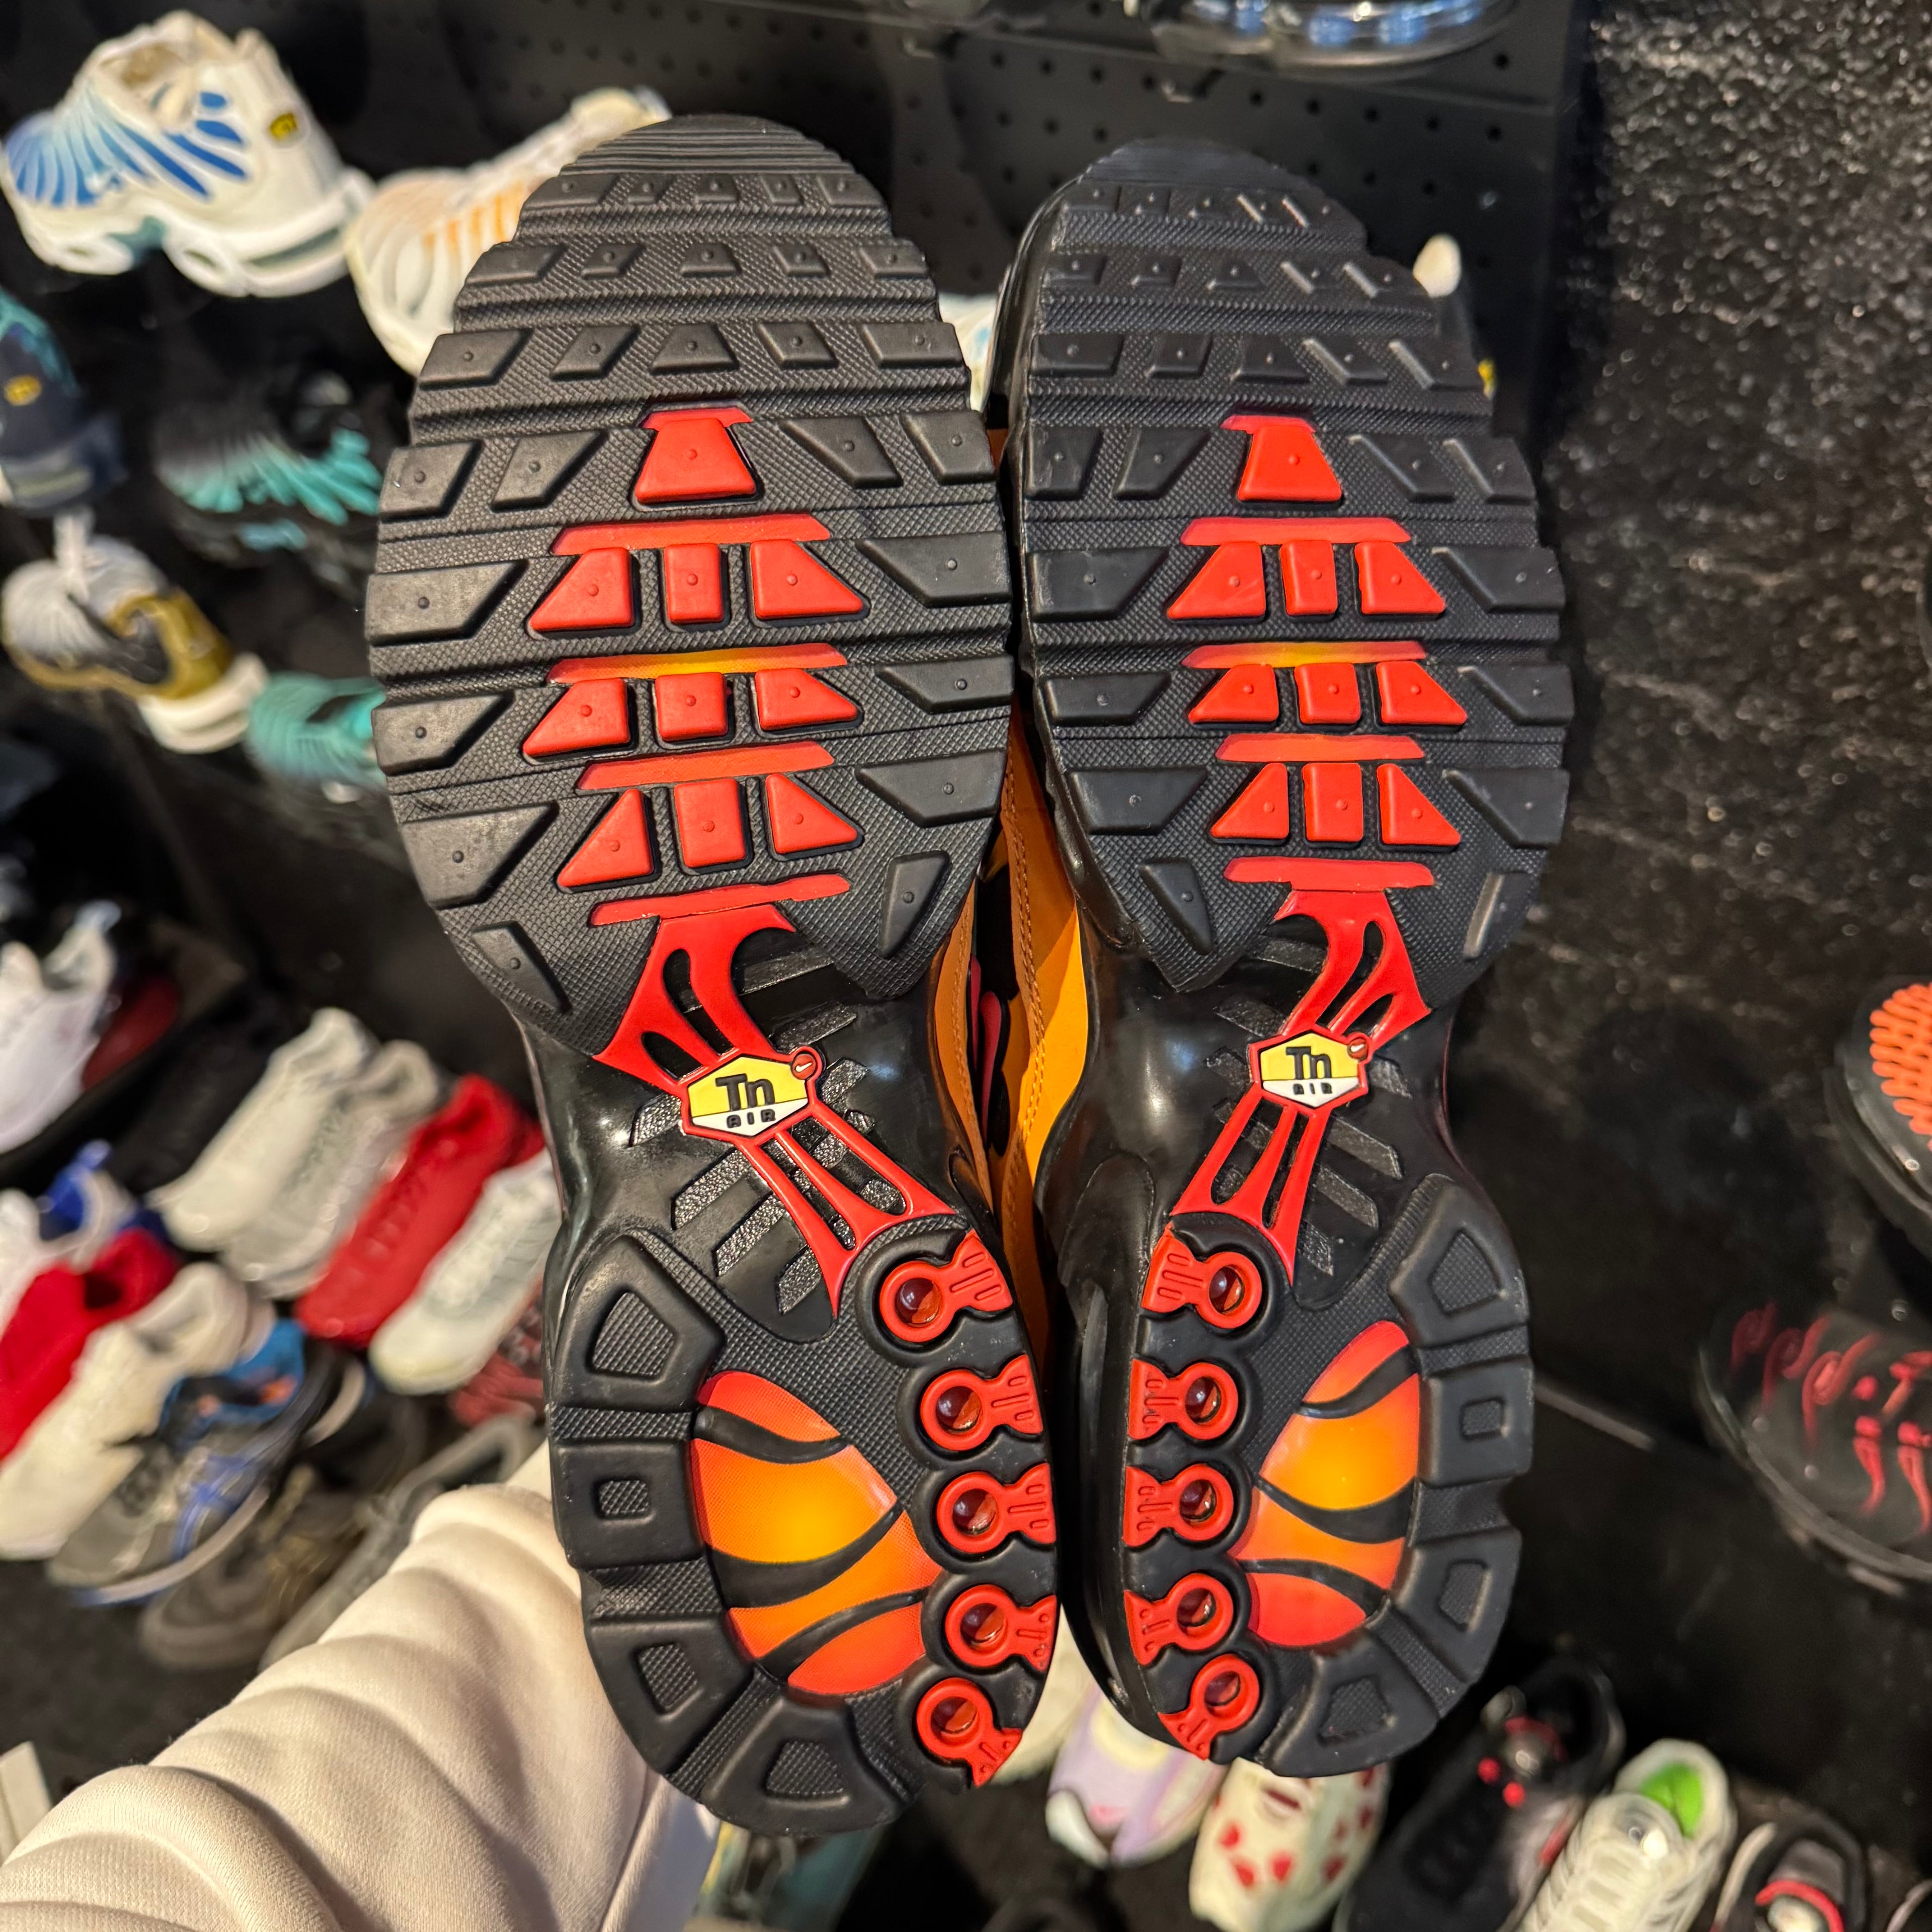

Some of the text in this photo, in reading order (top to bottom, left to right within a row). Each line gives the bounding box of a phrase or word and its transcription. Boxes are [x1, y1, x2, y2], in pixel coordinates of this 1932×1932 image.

[1285, 1046, 1332, 1080] Tn
[715, 1073, 775, 1111] Tn
[727, 1109, 776, 1129] AIR
